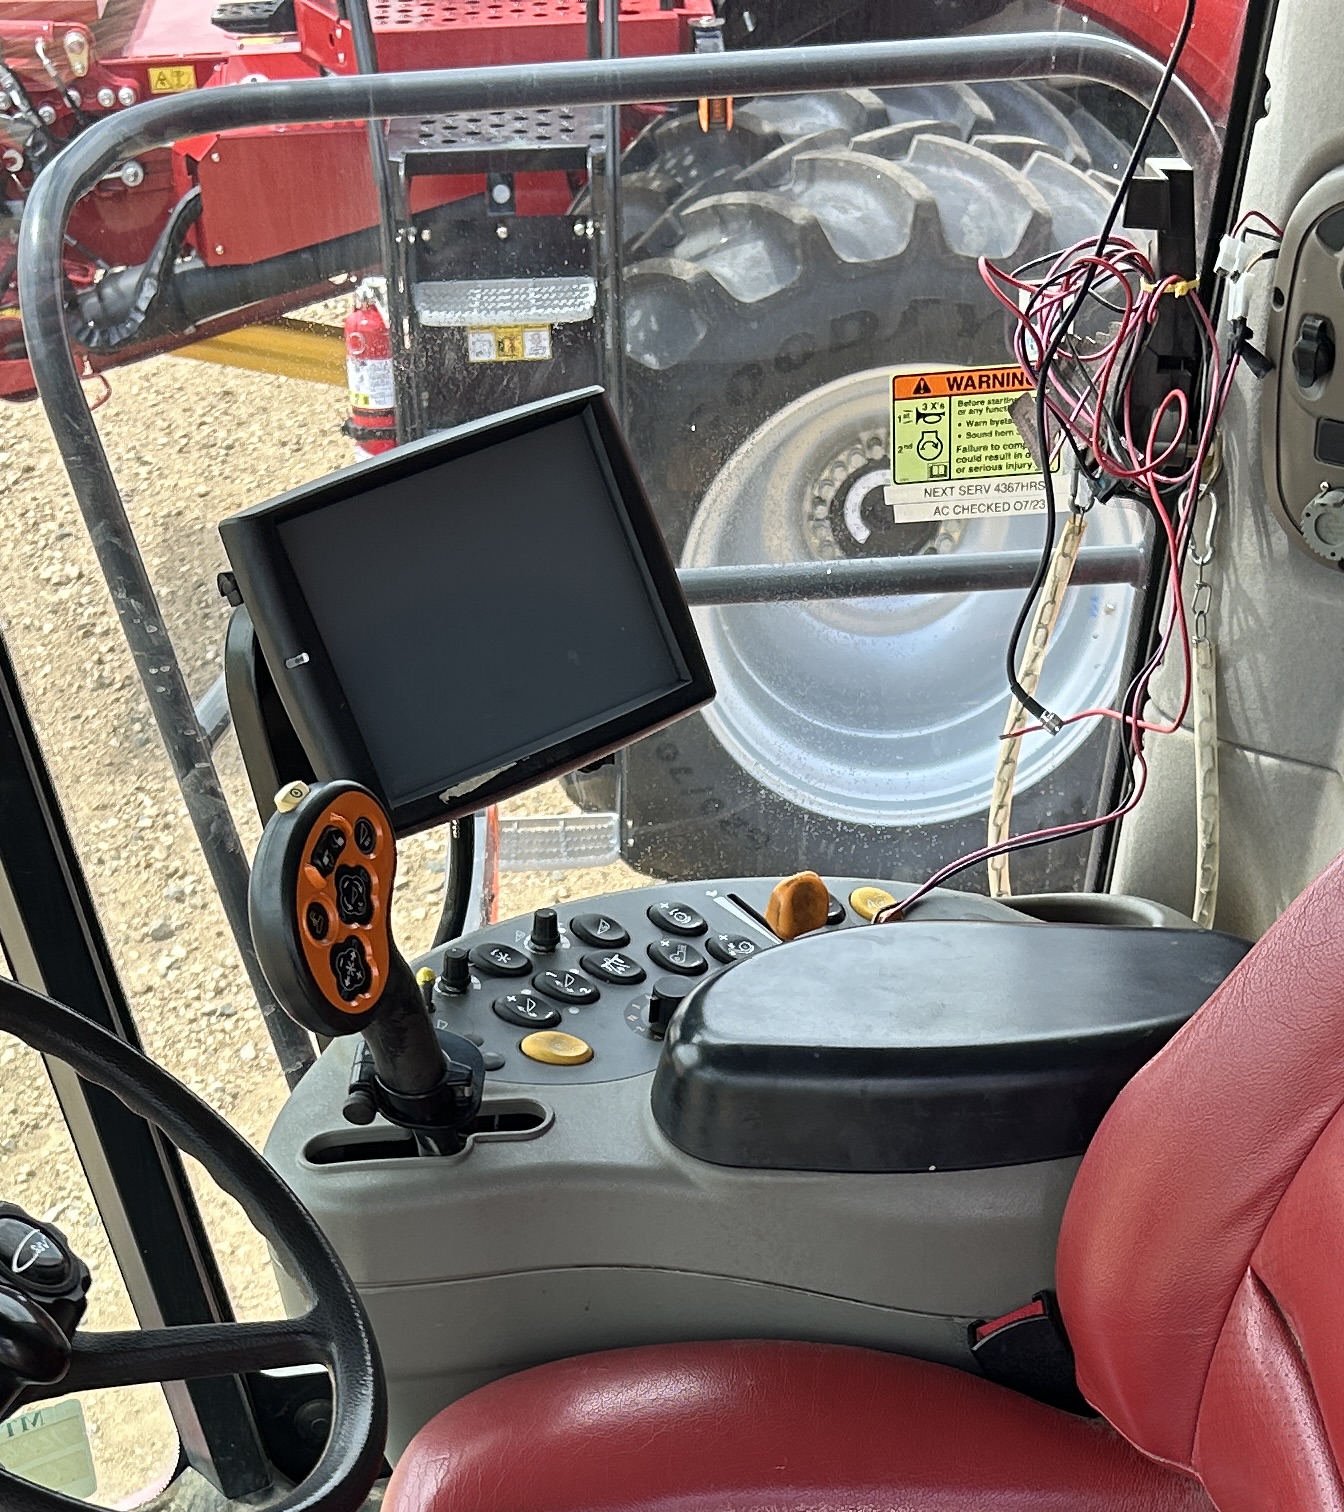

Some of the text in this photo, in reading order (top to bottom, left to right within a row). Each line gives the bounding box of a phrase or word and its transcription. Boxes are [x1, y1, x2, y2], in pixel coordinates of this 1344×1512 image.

[957, 399, 985, 408] Before
[986, 405, 1007, 413] funct
[990, 418, 1013, 427] bysta
[965, 430, 992, 439] Sound
[956, 444, 988, 453] Failure
[990, 443, 1000, 451] to
[956, 454, 982, 463] could
[984, 452, 1011, 461] result
[968, 464, 1003, 473] serious
[924, 481, 1046, 498] NEXT SERV 4367HRS
[933, 506, 950, 516] AC
[953, 501, 1011, 515] CHECKED
